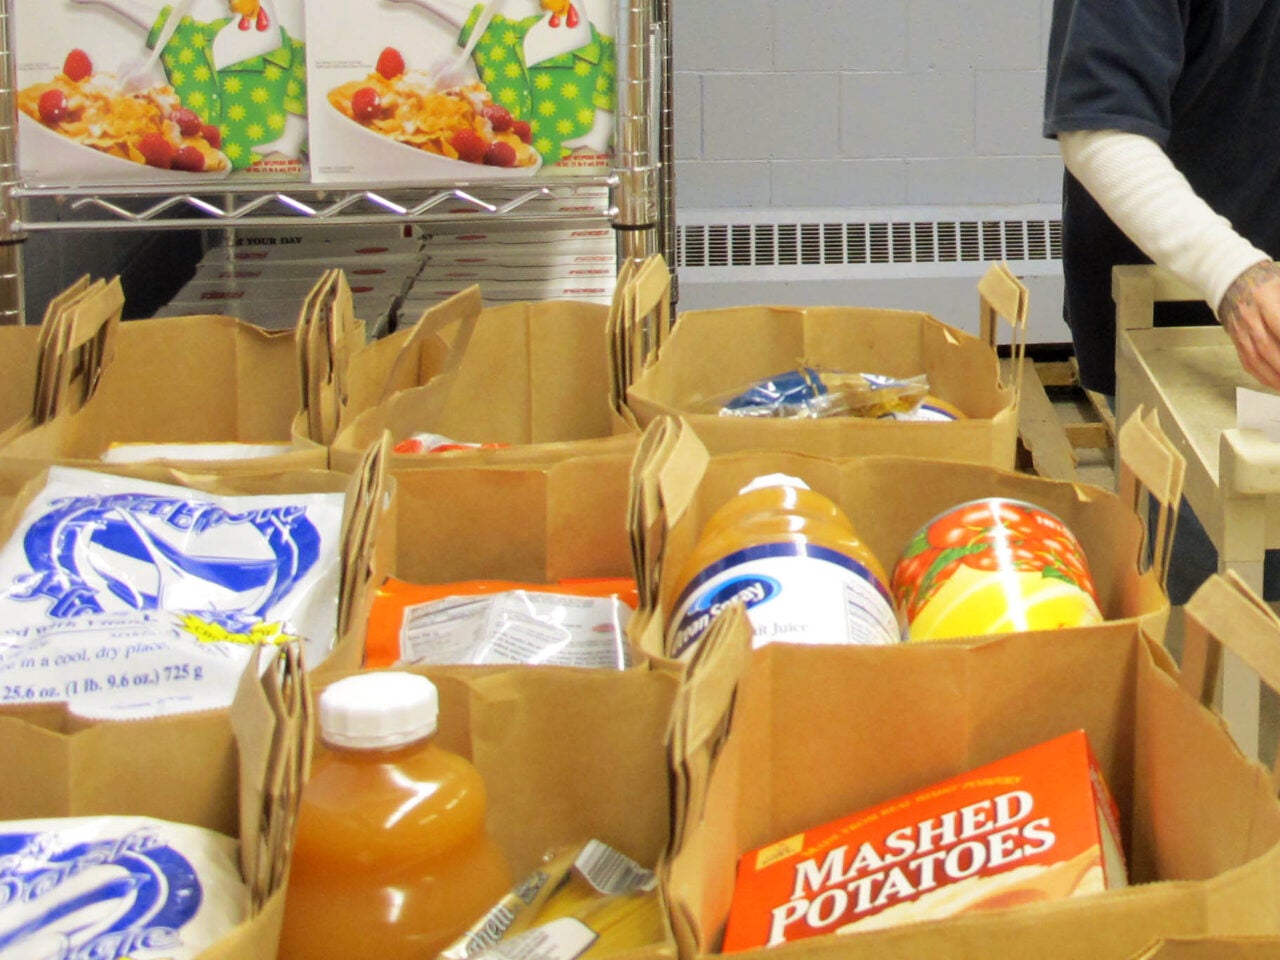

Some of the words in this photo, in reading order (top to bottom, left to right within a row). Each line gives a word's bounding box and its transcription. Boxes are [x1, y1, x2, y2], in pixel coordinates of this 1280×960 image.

[2, 685, 35, 701] 25.6
[39, 686, 60, 700] oz.
[84, 676, 103, 693] lb.
[107, 672, 130, 690] 9.6
[133, 669, 160, 688] oz.)
[163, 663, 191, 682] 725
[40, 656, 50, 668] a
[766, 816, 1057, 949] POTATOES
[789, 790, 1034, 902] MASHED
